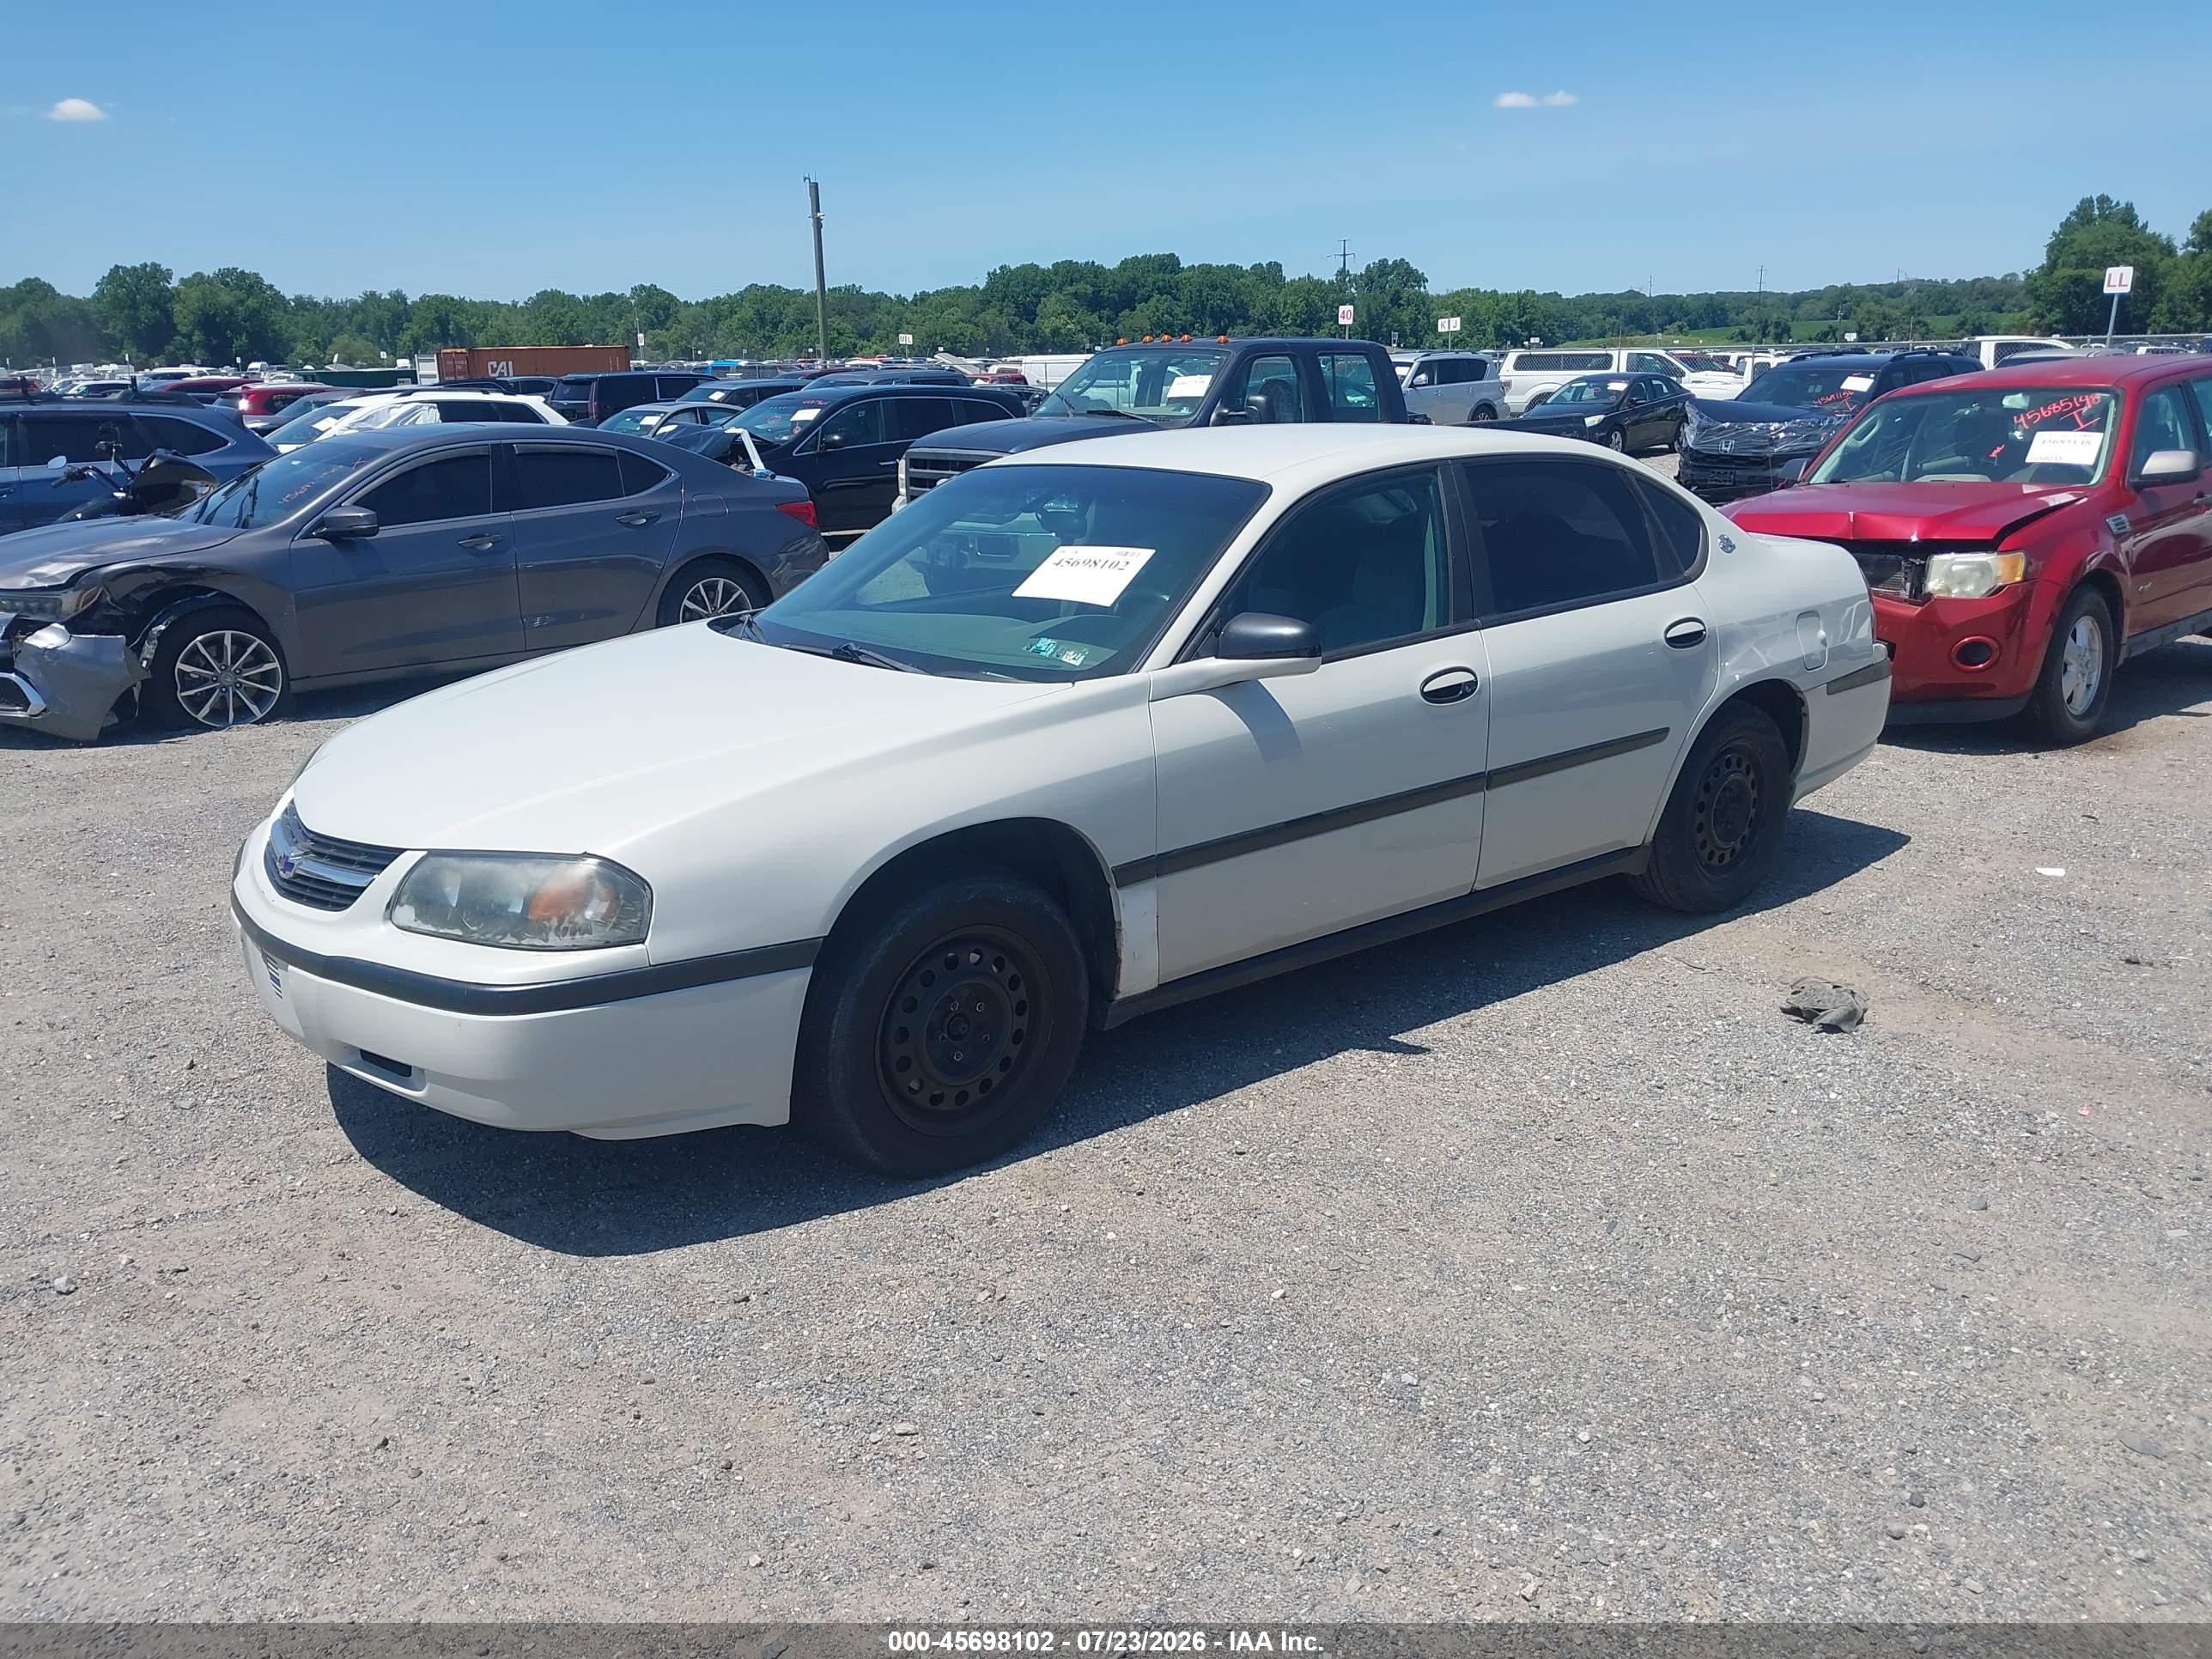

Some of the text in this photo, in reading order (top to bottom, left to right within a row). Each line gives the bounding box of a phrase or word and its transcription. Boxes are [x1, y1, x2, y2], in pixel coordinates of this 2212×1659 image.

[2106, 272, 2129, 288] LL
[1340, 309, 1352, 321] 40
[1440, 320, 1458, 331] K J
[487, 361, 514, 377] CAI
[2013, 392, 2102, 429] 45685148
[1052, 557, 1130, 571] 45698102
